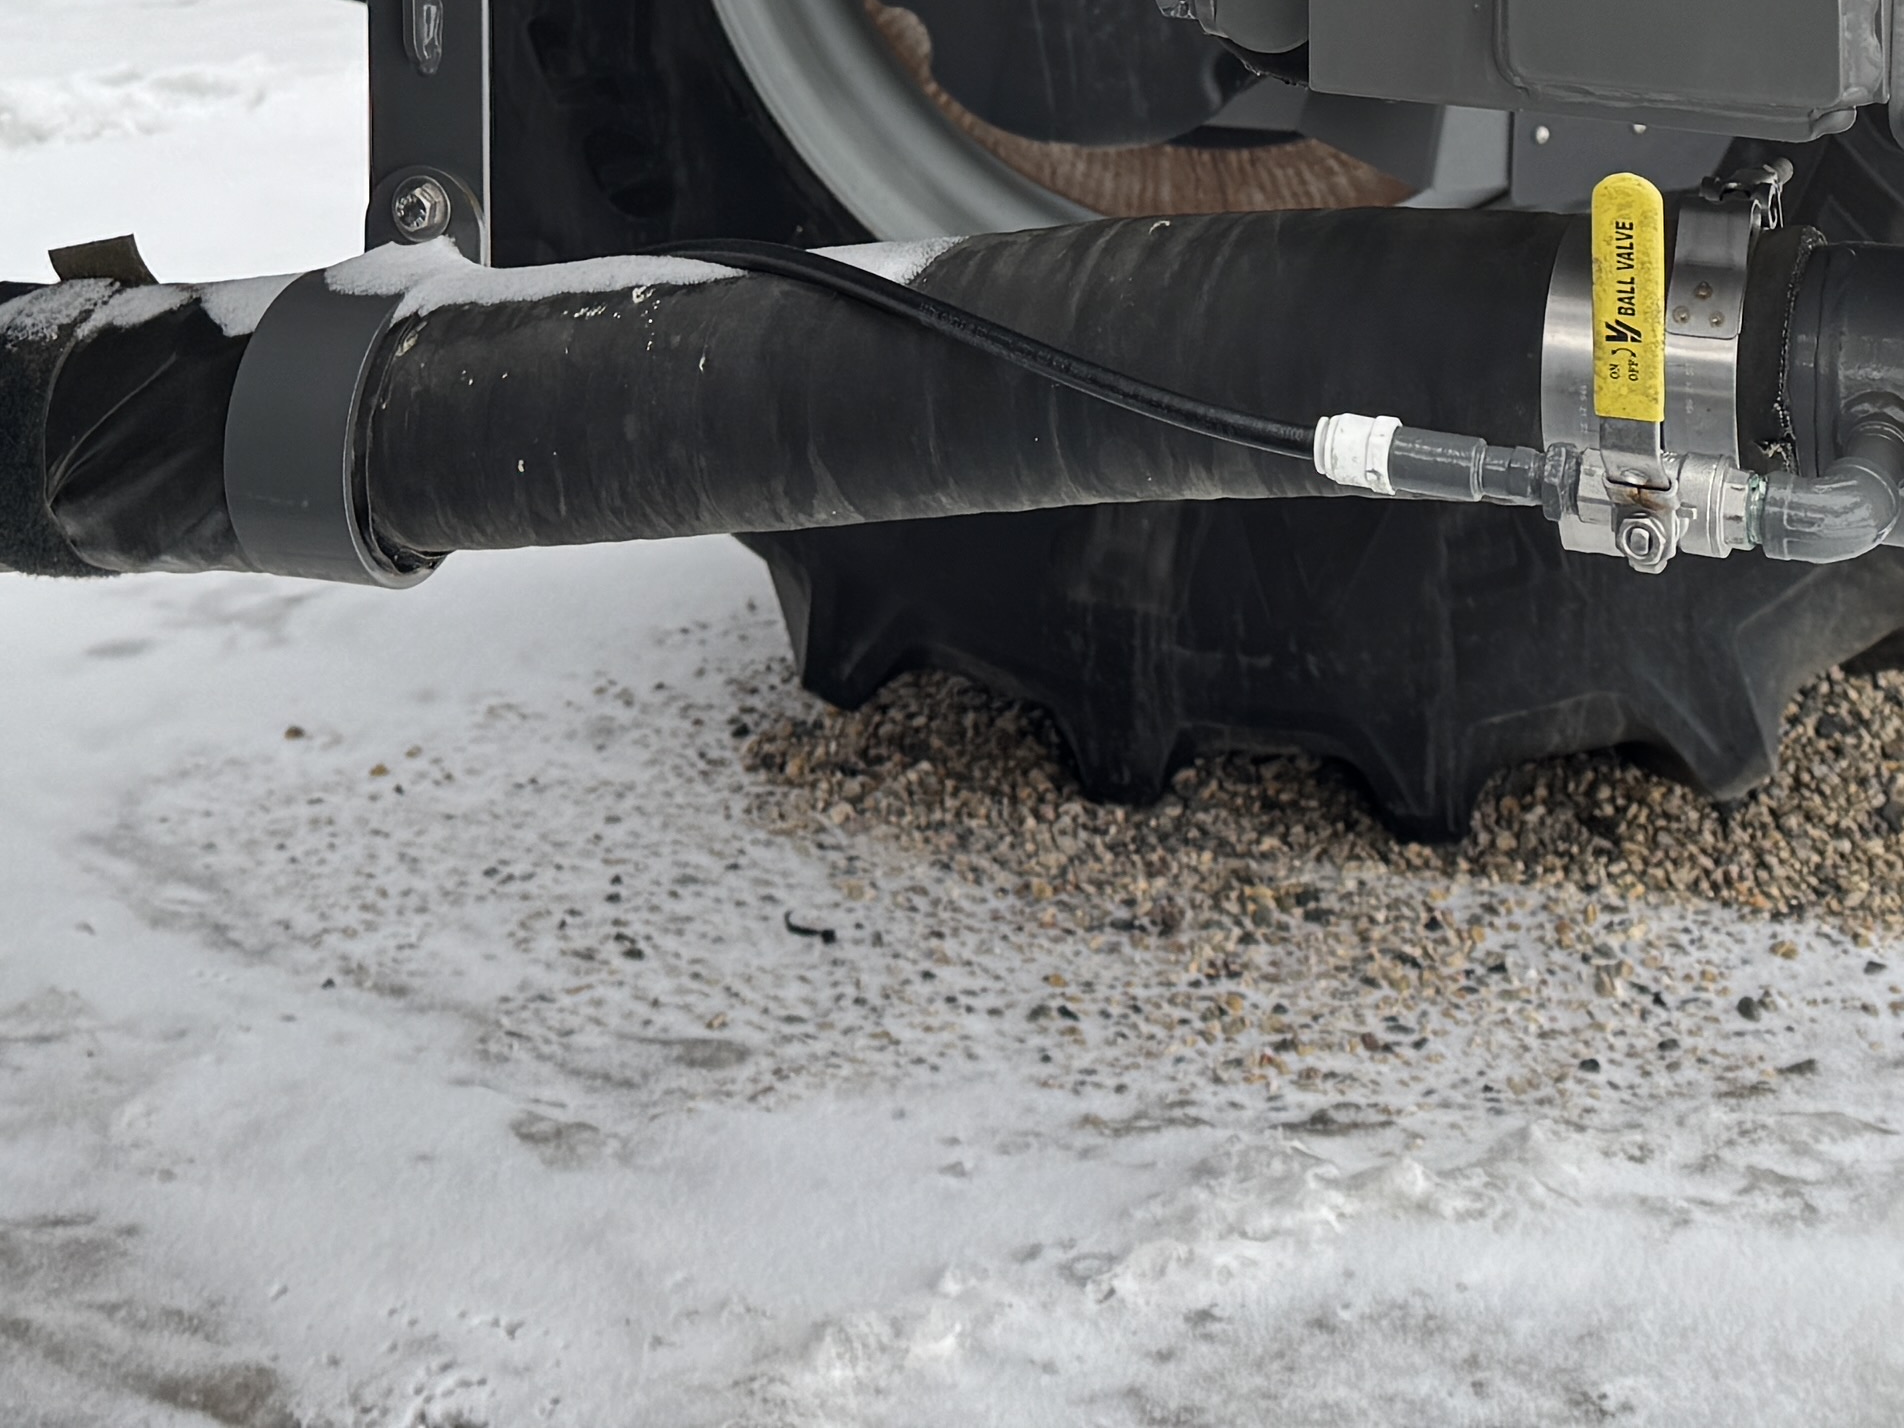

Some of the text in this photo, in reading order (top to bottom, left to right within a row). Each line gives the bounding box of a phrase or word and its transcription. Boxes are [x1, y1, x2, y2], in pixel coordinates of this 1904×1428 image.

[1614, 220, 1636, 318] BALL VALVE
[1609, 362, 1619, 381] ON
[1628, 358, 1640, 383] OFF
